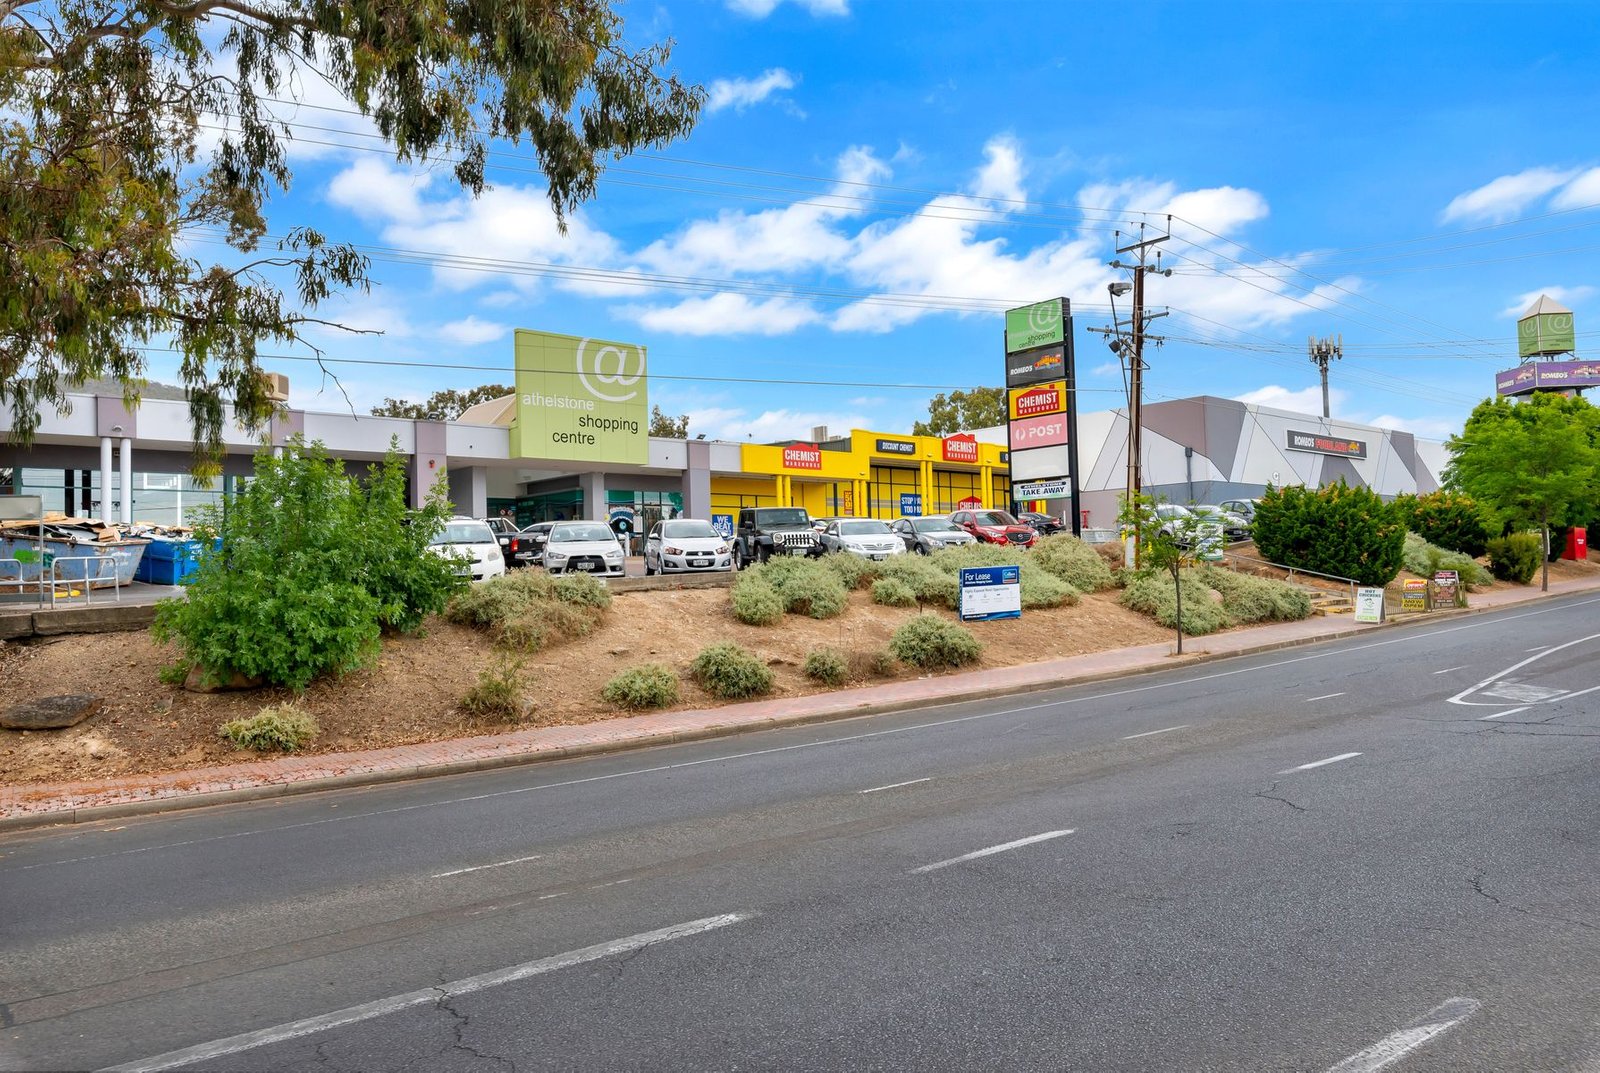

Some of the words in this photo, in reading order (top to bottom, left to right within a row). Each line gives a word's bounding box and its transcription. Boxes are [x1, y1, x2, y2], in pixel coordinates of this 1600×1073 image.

[1027, 330, 1056, 342] shopping
[577, 337, 645, 402] @
[522, 392, 595, 411] athelstone
[1018, 391, 1058, 409] CHEMIST
[1019, 404, 1058, 415] WAREHOUSE
[578, 414, 639, 434] shopping
[1028, 423, 1062, 439] POST
[552, 431, 595, 445] centre
[882, 441, 899, 451] DISCOUNT
[899, 443, 914, 452] CHEMIST
[946, 440, 977, 454] CHEMIST
[784, 449, 820, 462] CHEMIST
[785, 460, 820, 468] WAREHOUSE
[1022, 488, 1041, 496] TAKE
[1043, 486, 1065, 495] AWAY
[901, 496, 914, 505] STOP
[959, 501, 982, 511] CHEMIS
[904, 505, 914, 514] TOO
[717, 516, 729, 524] WE
[713, 522, 732, 530] BEAT
[965, 573, 975, 581] For
[975, 572, 991, 580] Lease
